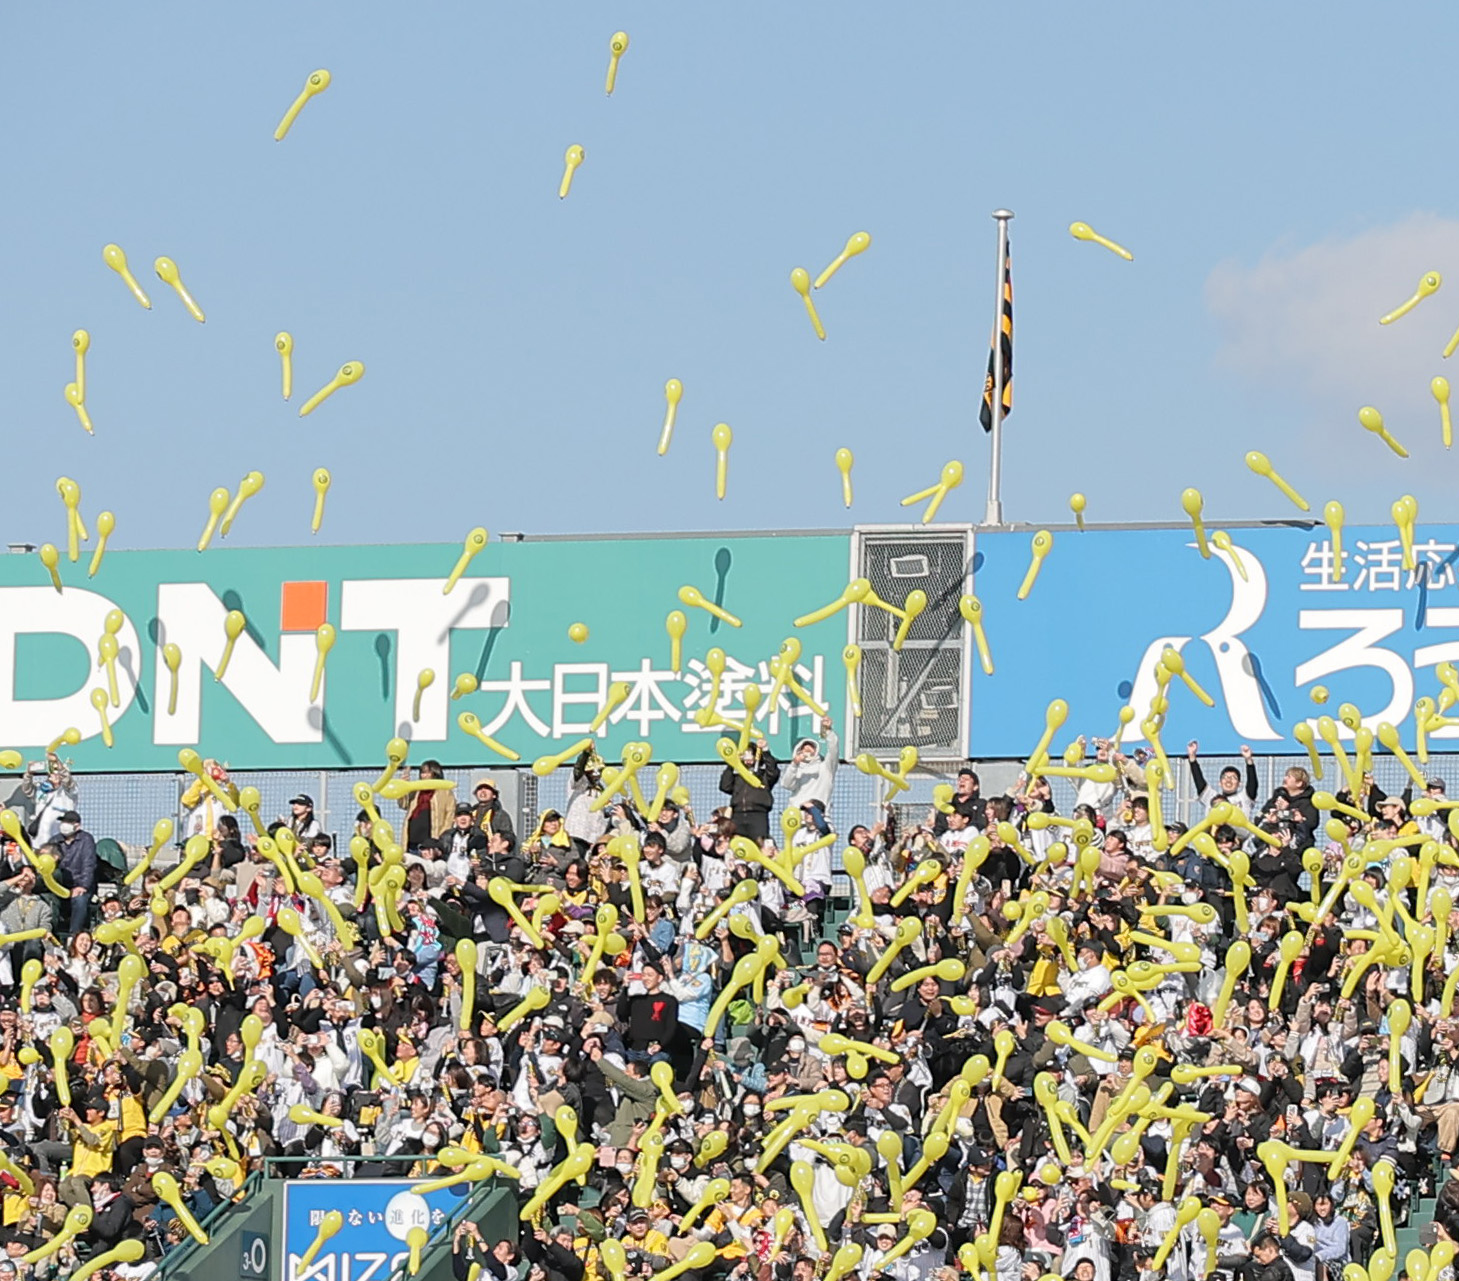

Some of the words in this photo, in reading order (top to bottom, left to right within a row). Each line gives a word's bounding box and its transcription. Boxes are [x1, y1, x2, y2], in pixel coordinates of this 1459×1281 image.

[0, 577, 511, 748] DNT
[480, 654, 831, 740] 大日本塗料
[309, 1208, 445, 1227] 限ない進化を
